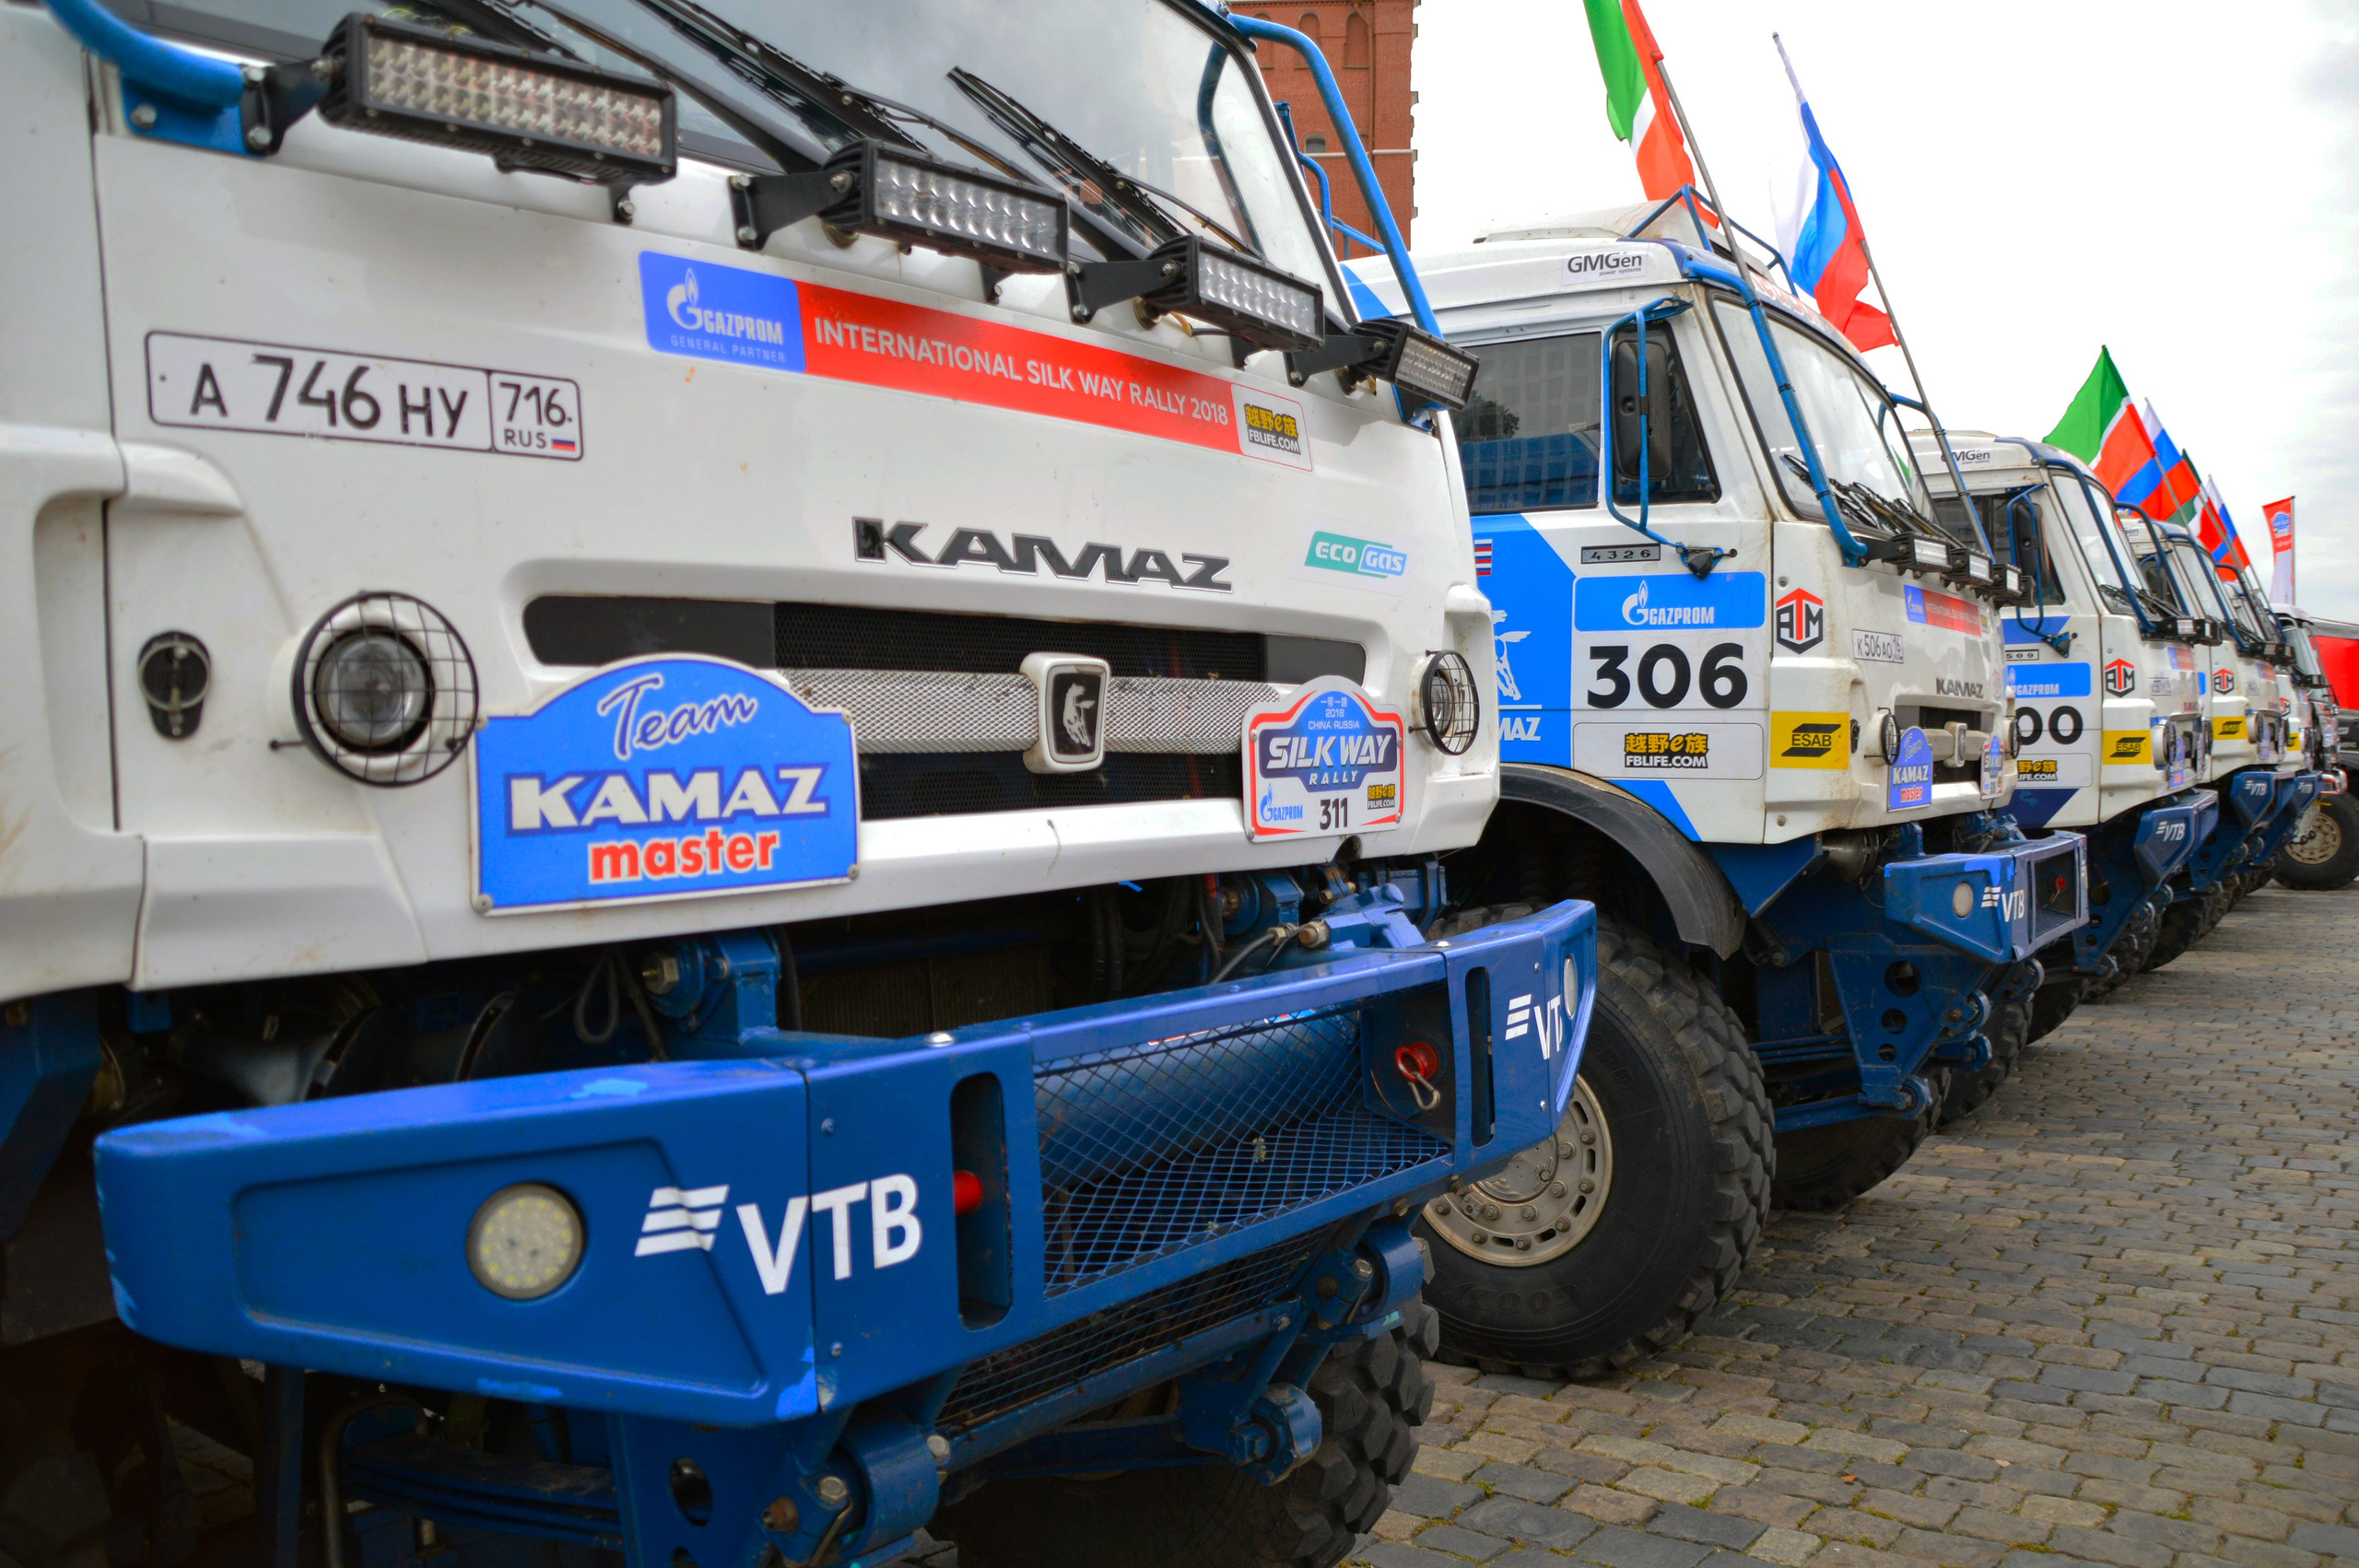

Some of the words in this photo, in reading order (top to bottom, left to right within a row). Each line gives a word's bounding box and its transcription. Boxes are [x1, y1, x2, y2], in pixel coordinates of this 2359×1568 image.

[1567, 252, 1642, 274] GMGen
[703, 310, 783, 345] GAZPROM
[670, 334, 727, 355] GENERAL
[732, 344, 786, 363] PARTNER
[815, 317, 1023, 382] INTERNATIONAL
[1027, 359, 1076, 392] SILK
[1079, 370, 1123, 402] WAY
[1128, 381, 1187, 415] RALLY
[1191, 397, 1230, 427] 2018
[252, 354, 381, 431] 746
[499, 380, 568, 427] 716
[503, 427, 547, 450] RUS
[1248, 428, 1301, 455] FBLIFE.COM
[1942, 450, 1990, 462] MGen
[852, 516, 1233, 593] KAMAZ
[1315, 541, 1356, 564] ECO
[1590, 549, 1651, 561] 4326
[1649, 606, 1714, 626] GAZPROM
[1864, 634, 1882, 658] 506
[1587, 643, 1748, 709] 306
[1936, 678, 1984, 699] KAMAZ
[2015, 683, 2060, 696] GAZPROM
[597, 673, 757, 760] Team
[1325, 708, 1344, 718] 2018
[1266, 737, 1336, 770] SILK
[1340, 734, 1392, 767] WAY
[1791, 734, 1832, 747] ESAB
[2116, 743, 2142, 752] ESAB
[1625, 755, 1708, 768] FBLIFE.COM
[1309, 771, 1358, 787] RALLY
[1893, 765, 1930, 785] KAMAZ
[508, 766, 827, 834] KAMAZ
[2249, 783, 2267, 796] VTB
[1273, 804, 1303, 822] GAZPROM
[1319, 797, 1349, 831] 311
[1367, 800, 1396, 810] FBLIFE.COM
[2165, 822, 2186, 842] VTB
[589, 826, 780, 884] master
[2001, 889, 2025, 922] VTB
[736, 1174, 922, 1295] VTB
